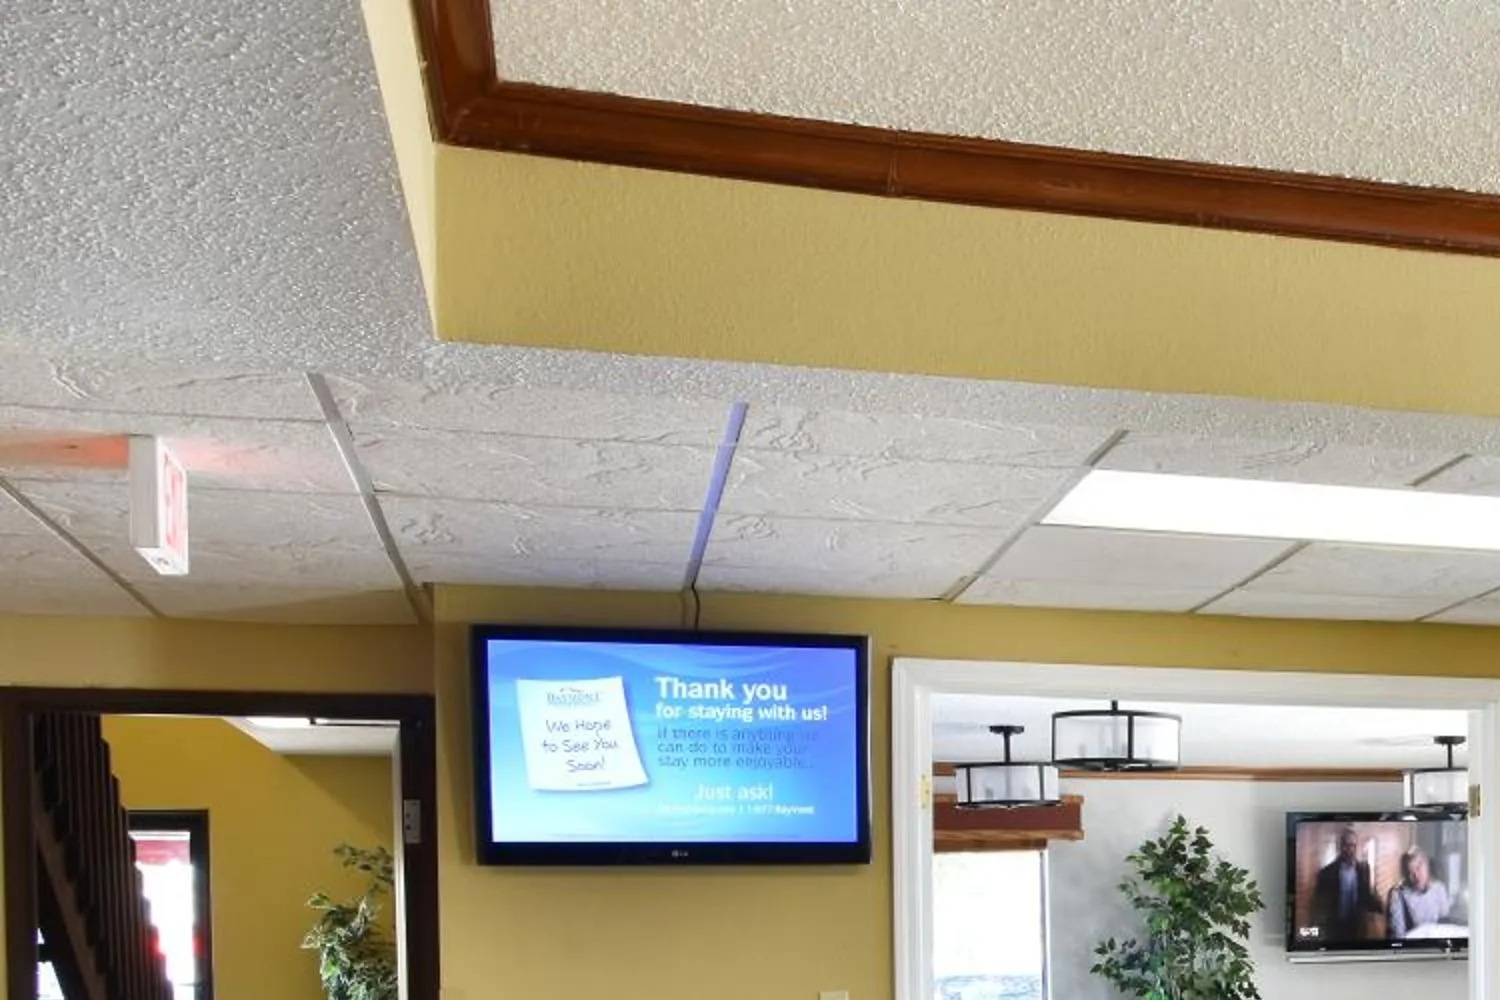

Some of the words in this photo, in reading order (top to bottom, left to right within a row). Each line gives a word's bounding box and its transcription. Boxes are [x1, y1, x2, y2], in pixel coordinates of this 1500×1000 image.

[655, 677, 734, 699] Thank
[742, 682, 787, 705] you
[655, 701, 682, 720] for
[688, 704, 753, 723] staying
[758, 705, 796, 721] with
[801, 706, 828, 721] us!
[545, 720, 570, 733] We
[575, 719, 612, 739] Hope
[672, 727, 711, 741] there
[716, 728, 729, 741] is
[542, 739, 558, 753] to
[561, 740, 589, 753] See
[593, 738, 619, 751] You
[657, 742, 684, 754] can
[687, 741, 709, 754] do
[713, 742, 728, 755] to
[732, 741, 772, 755] make
[657, 755, 689, 769] stay
[693, 756, 732, 768] more
[695, 783, 733, 800] Just
[737, 782, 774, 800] ask!
